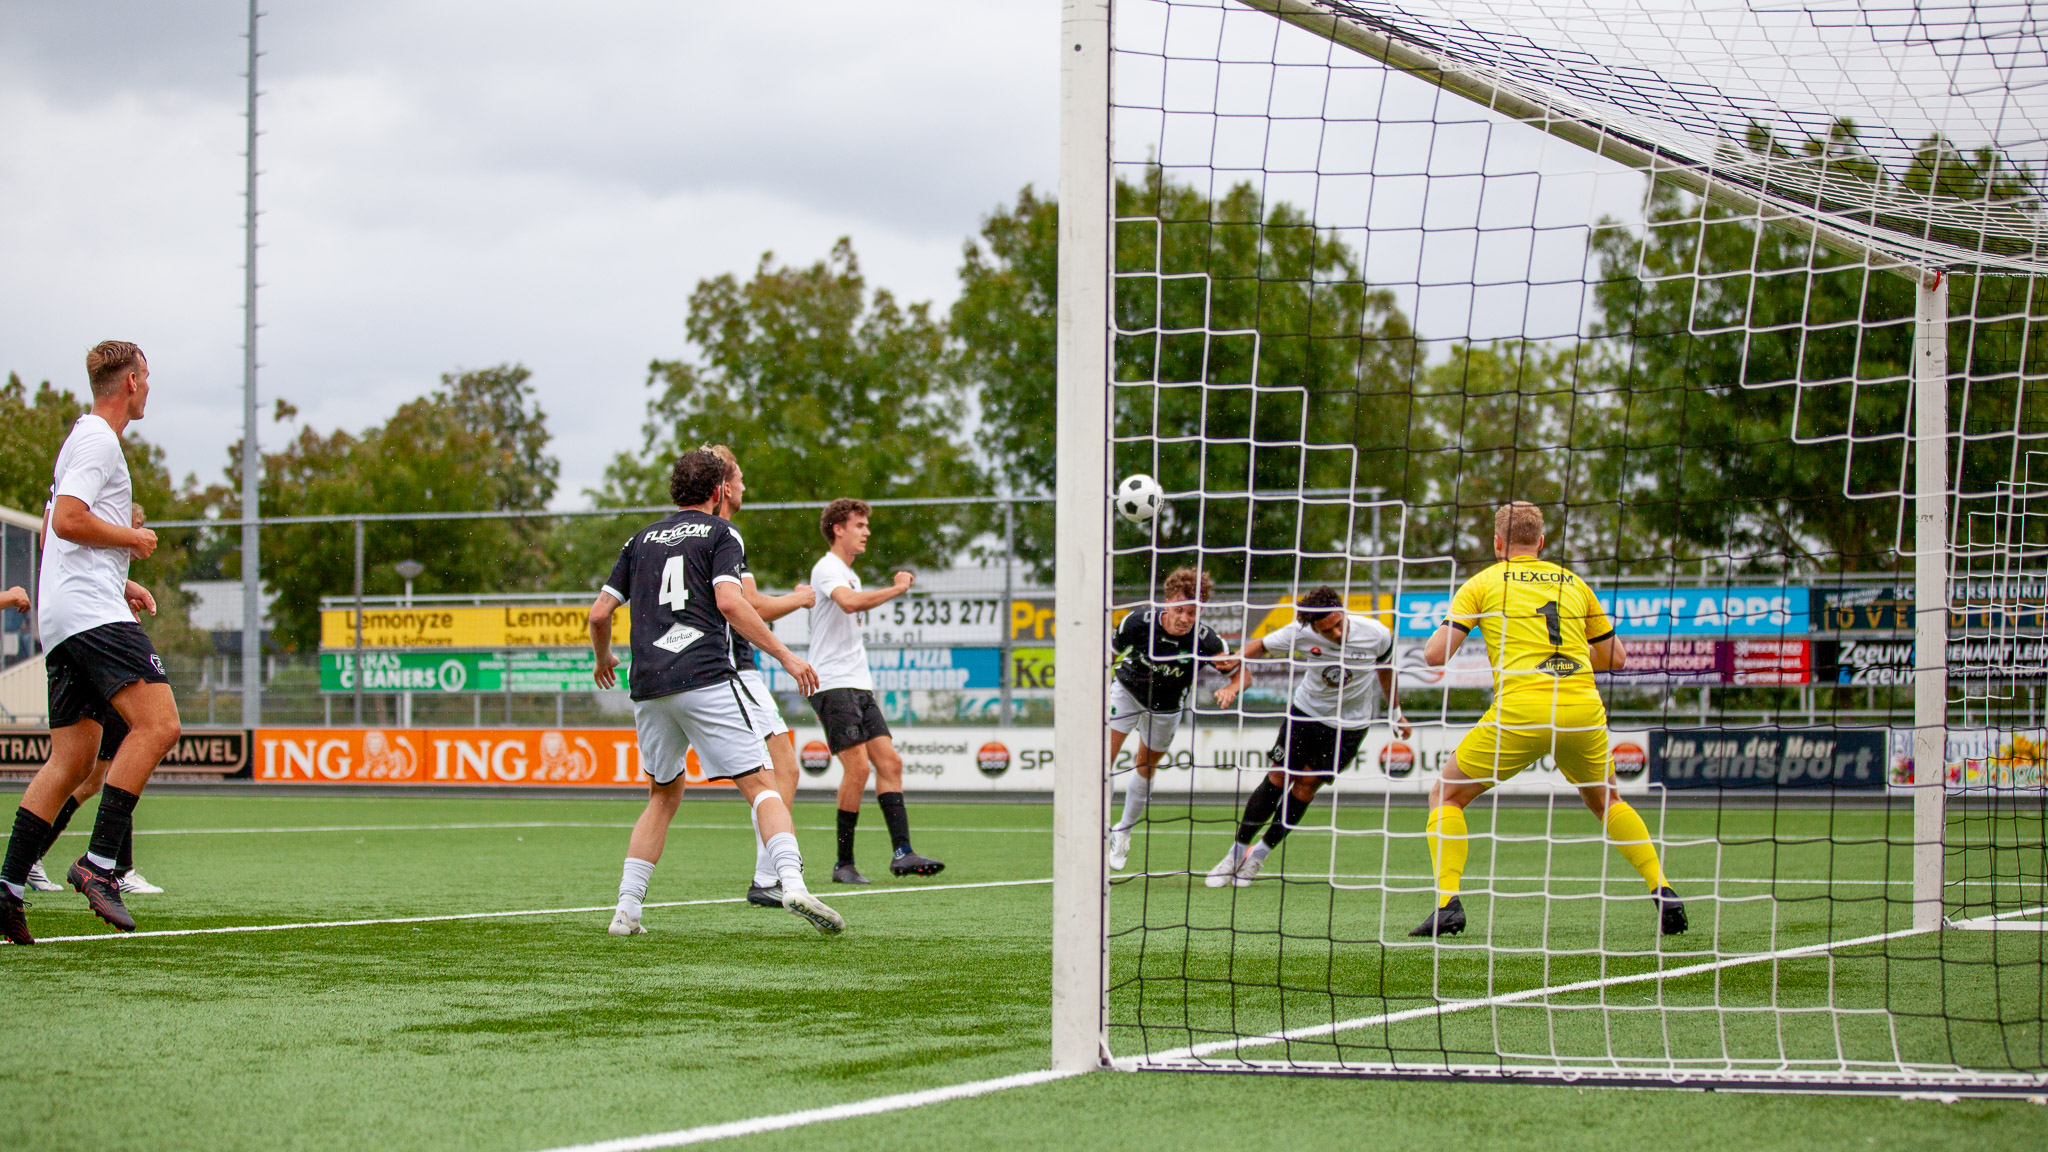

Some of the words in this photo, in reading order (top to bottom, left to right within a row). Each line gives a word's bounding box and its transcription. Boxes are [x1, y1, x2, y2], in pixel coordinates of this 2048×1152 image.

[643, 523, 712, 543] FLEXCOM
[658, 554, 689, 612] 4
[1503, 571, 1574, 583] FLEXCOM
[894, 602, 906, 625] 5
[912, 601, 951, 625] 233
[960, 600, 998, 625] 277
[1011, 601, 1055, 640] Pr
[1536, 601, 1562, 646] 1
[1693, 596, 1791, 627] APPS
[663, 631, 693, 645] Markus
[862, 629, 923, 645] sis.nl
[1838, 641, 1911, 664] Zeeuw
[339, 668, 437, 689] CEANERS
[1014, 658, 1055, 689] Ke
[261, 739, 352, 780] ING
[432, 739, 528, 781] ING
[893, 741, 969, 755] ofessional
[1658, 736, 1696, 759] Jan
[1703, 739, 1739, 758] van
[1744, 736, 1779, 758] der
[1784, 736, 1836, 758] Meer
[1666, 746, 1873, 785] transport
